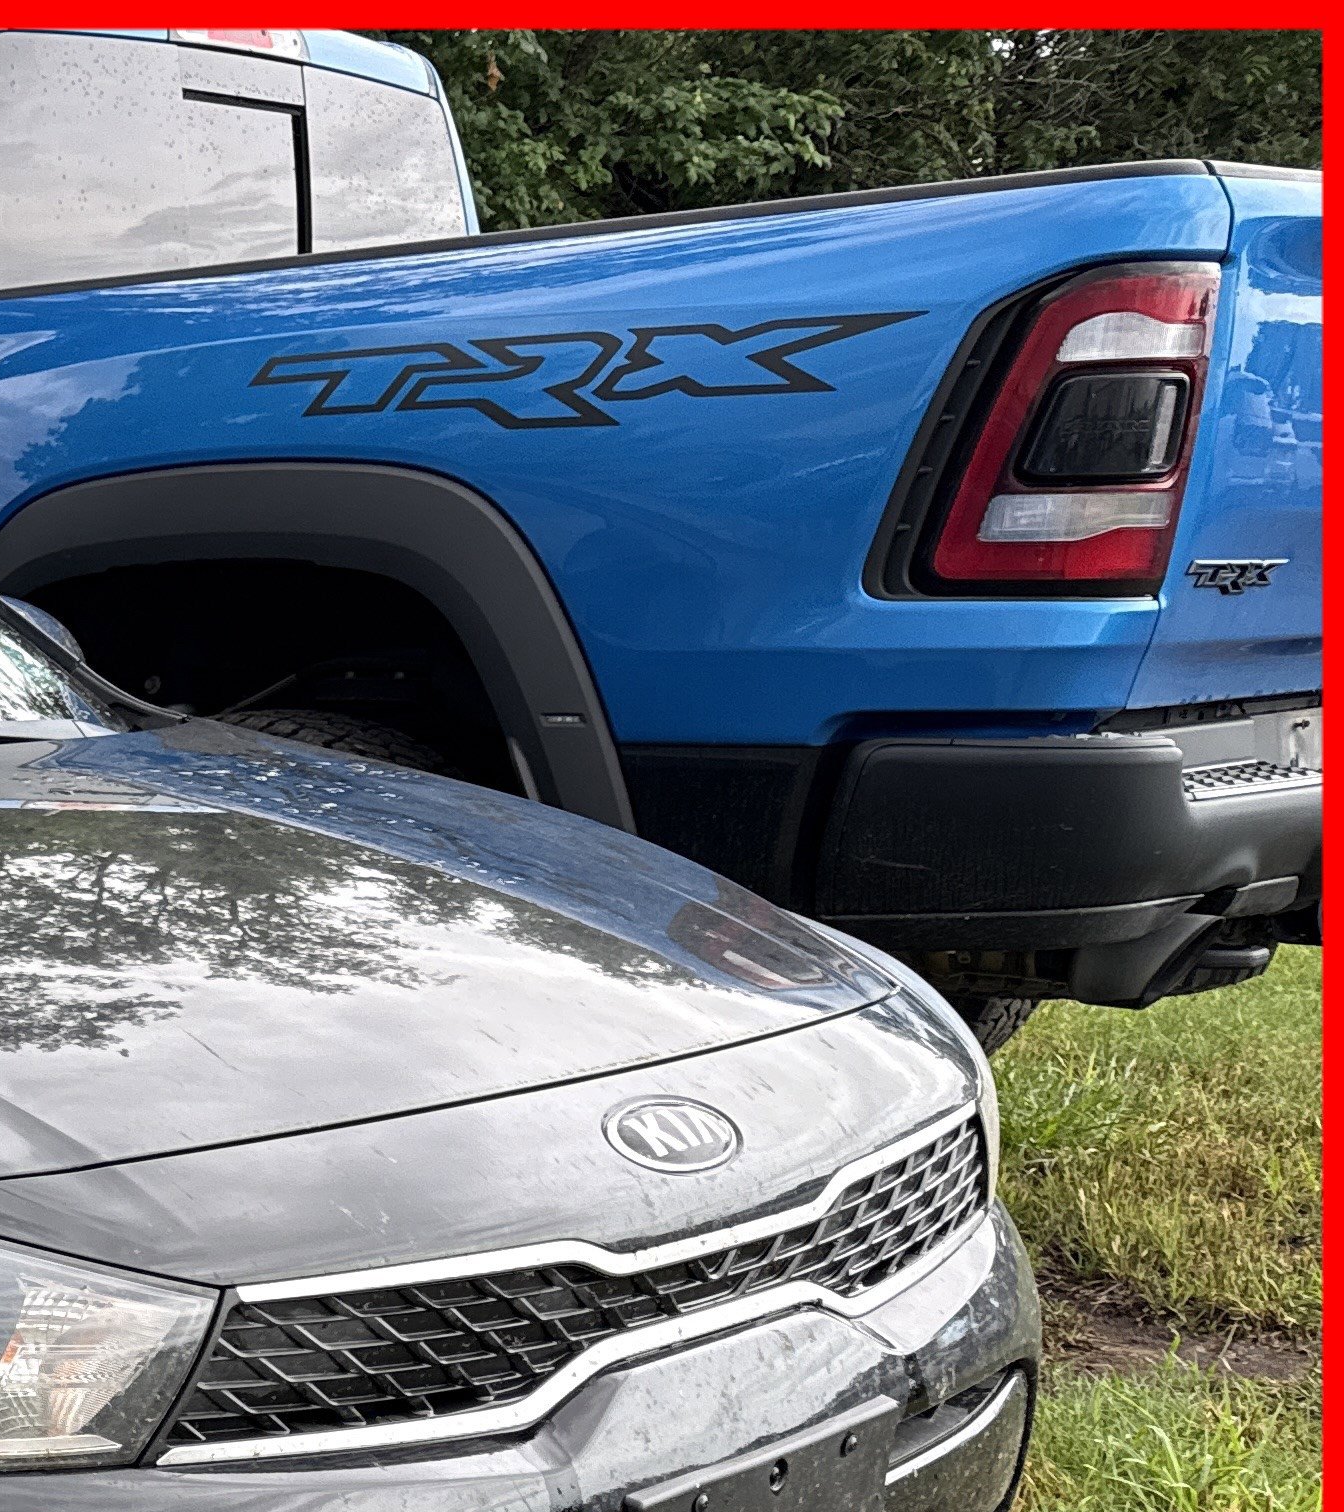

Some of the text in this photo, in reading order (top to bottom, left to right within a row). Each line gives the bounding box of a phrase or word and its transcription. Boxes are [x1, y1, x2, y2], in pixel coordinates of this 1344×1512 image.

[249, 309, 931, 430] TRX
[1185, 558, 1291, 595] TRX
[622, 1107, 730, 1158] KIA
